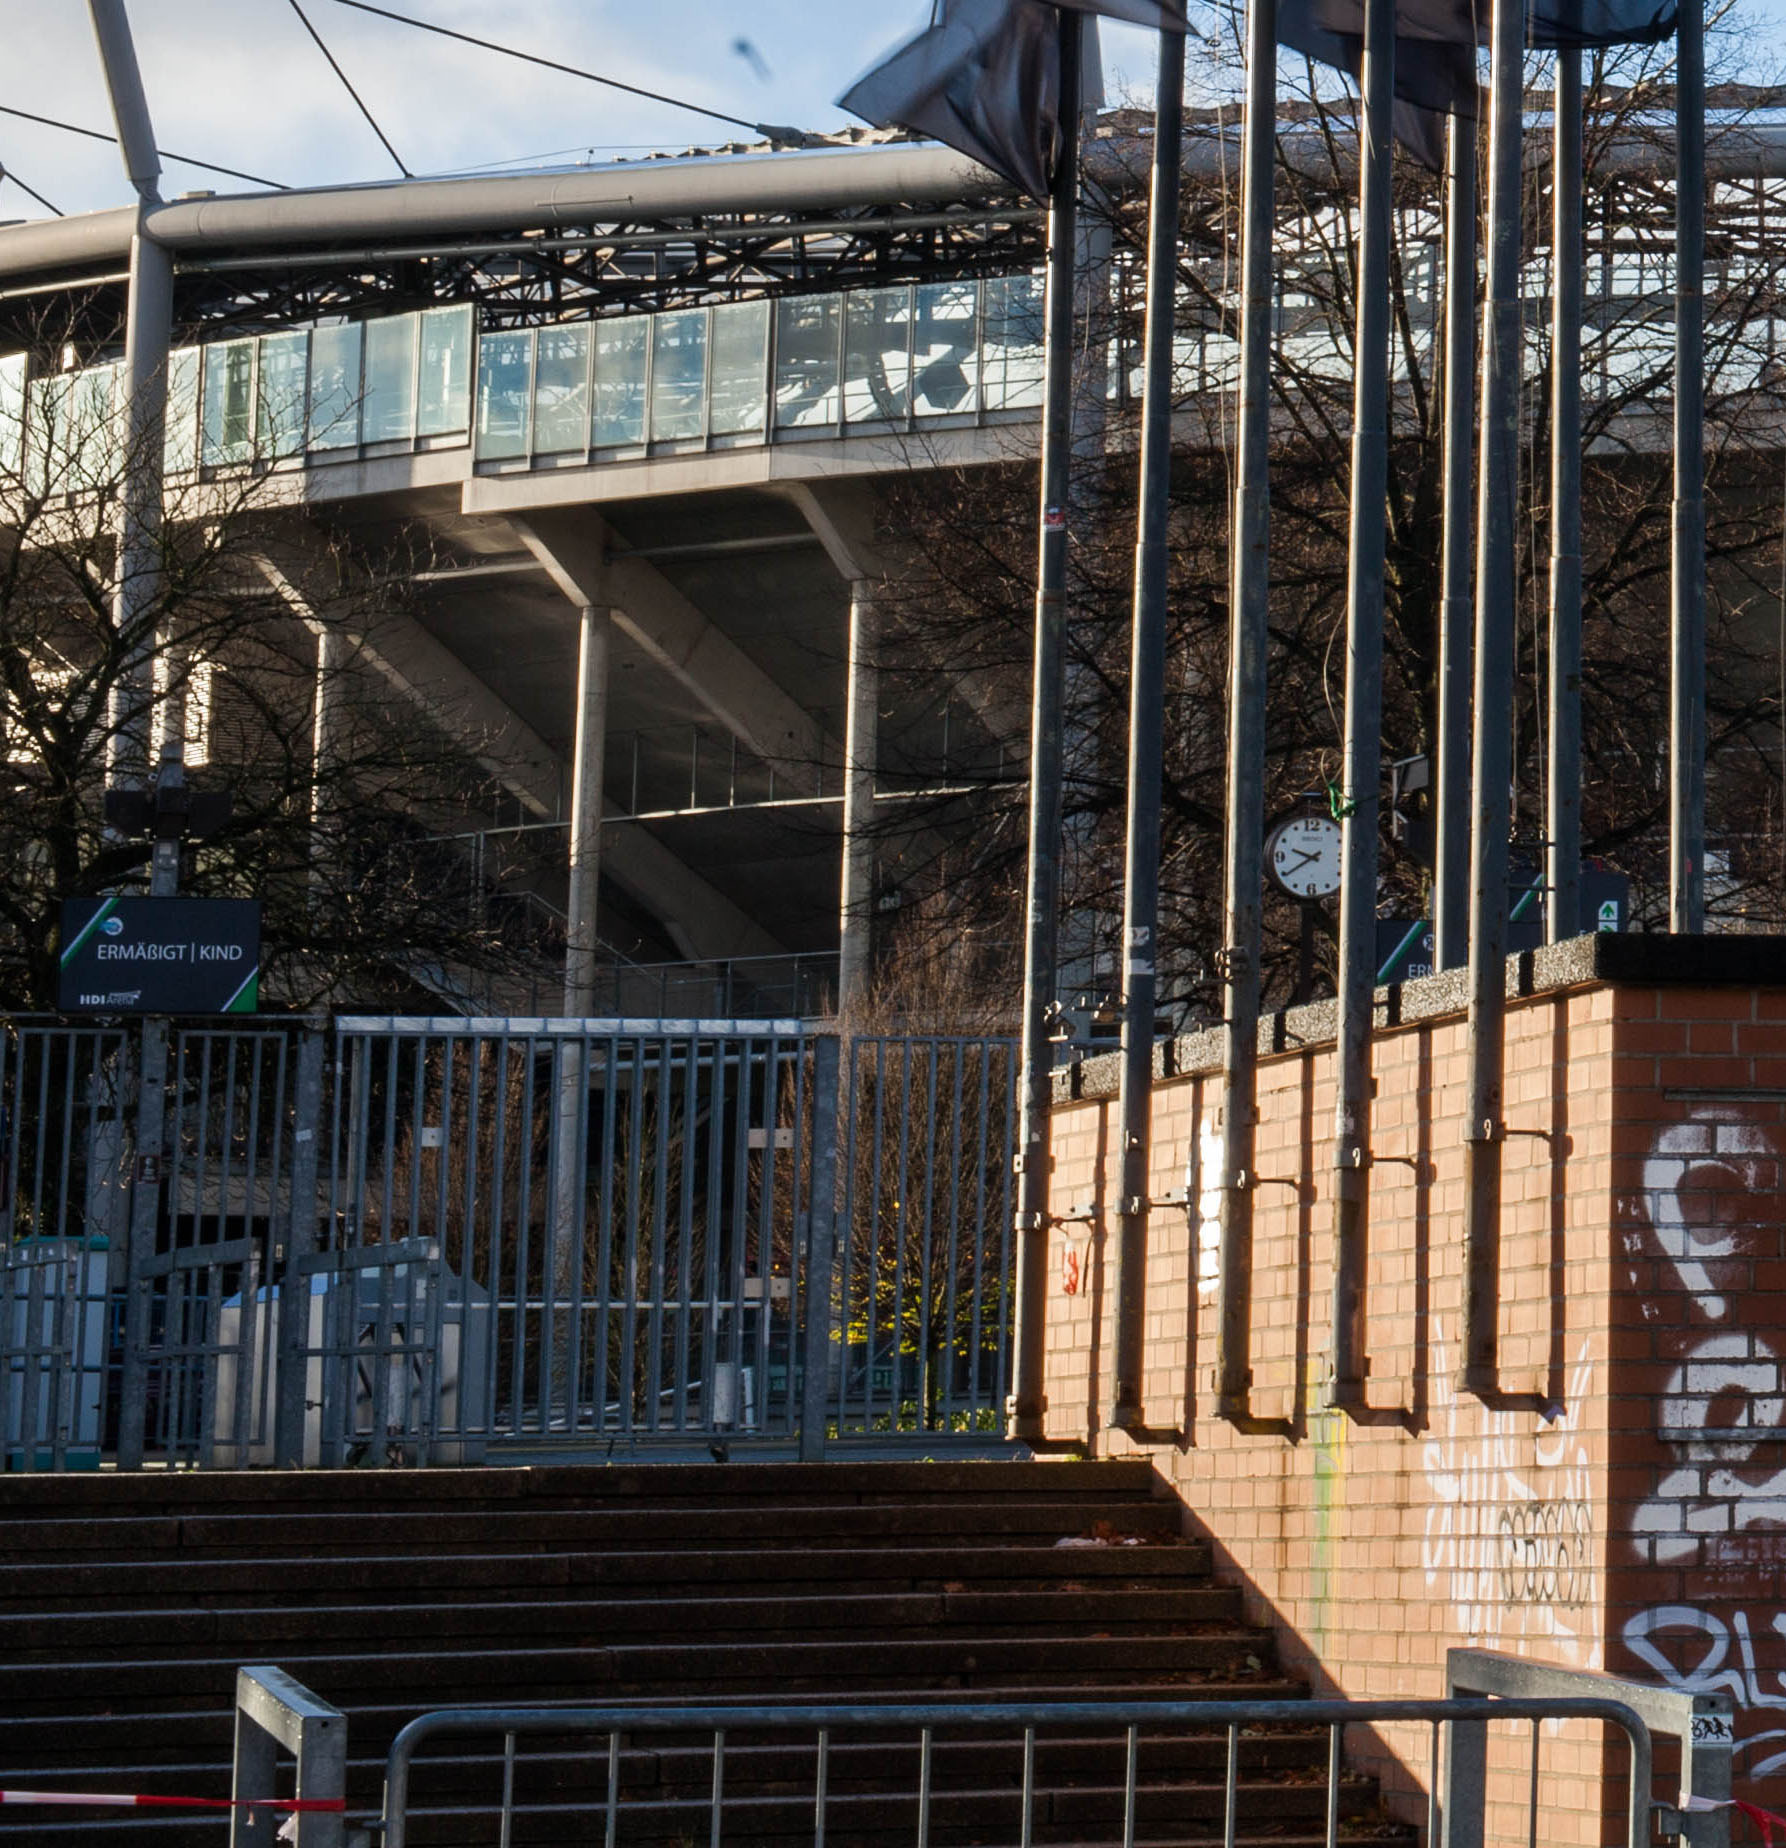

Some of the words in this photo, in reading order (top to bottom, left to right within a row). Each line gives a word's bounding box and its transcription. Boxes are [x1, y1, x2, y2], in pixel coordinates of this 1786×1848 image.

[1304, 819, 1320, 832] 12
[199, 943, 243, 961] KIND
[79, 993, 106, 1006] HDI
